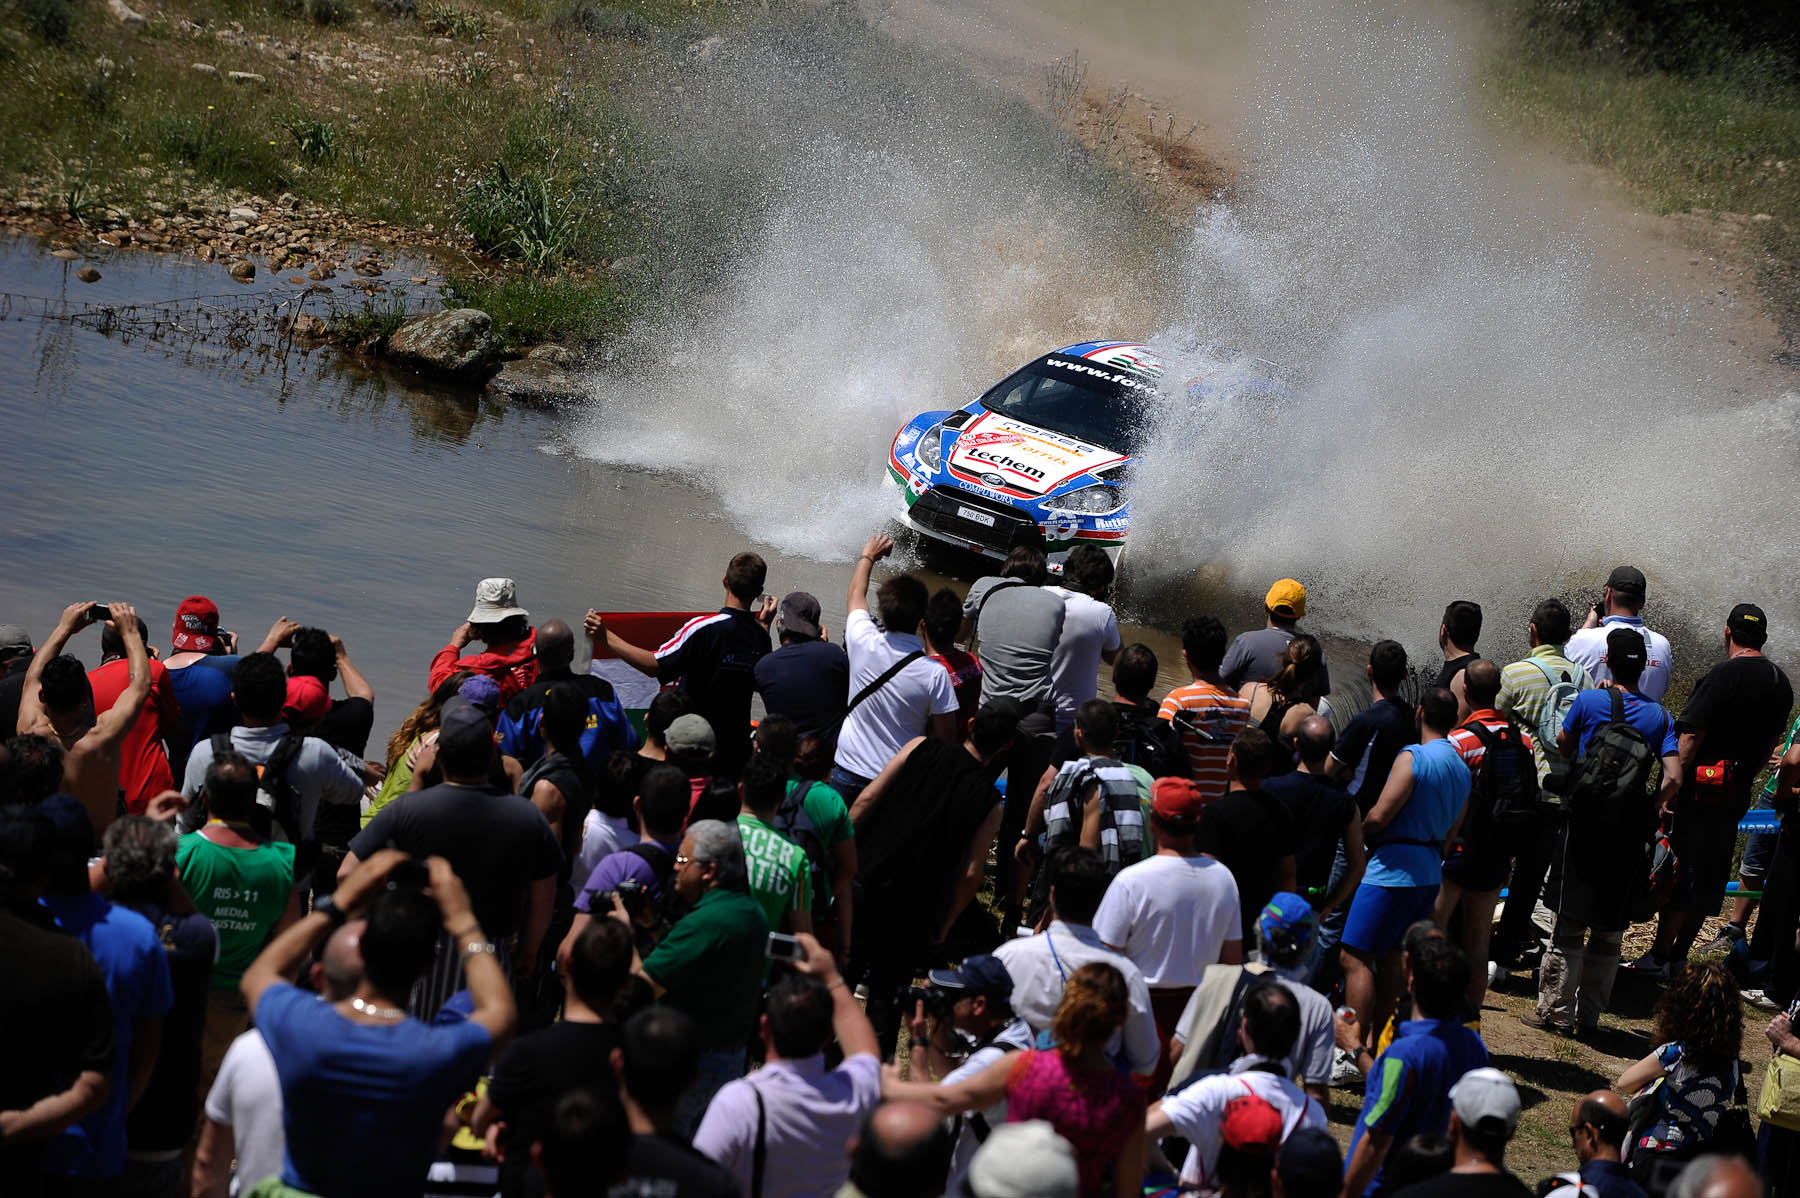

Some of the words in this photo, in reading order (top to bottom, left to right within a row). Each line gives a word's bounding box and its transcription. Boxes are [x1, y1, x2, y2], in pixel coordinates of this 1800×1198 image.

[968, 448, 1046, 479] techem
[959, 481, 1016, 505] COMPUWORX
[214, 887, 232, 900] RIS
[214, 906, 249, 919] MEDIA
